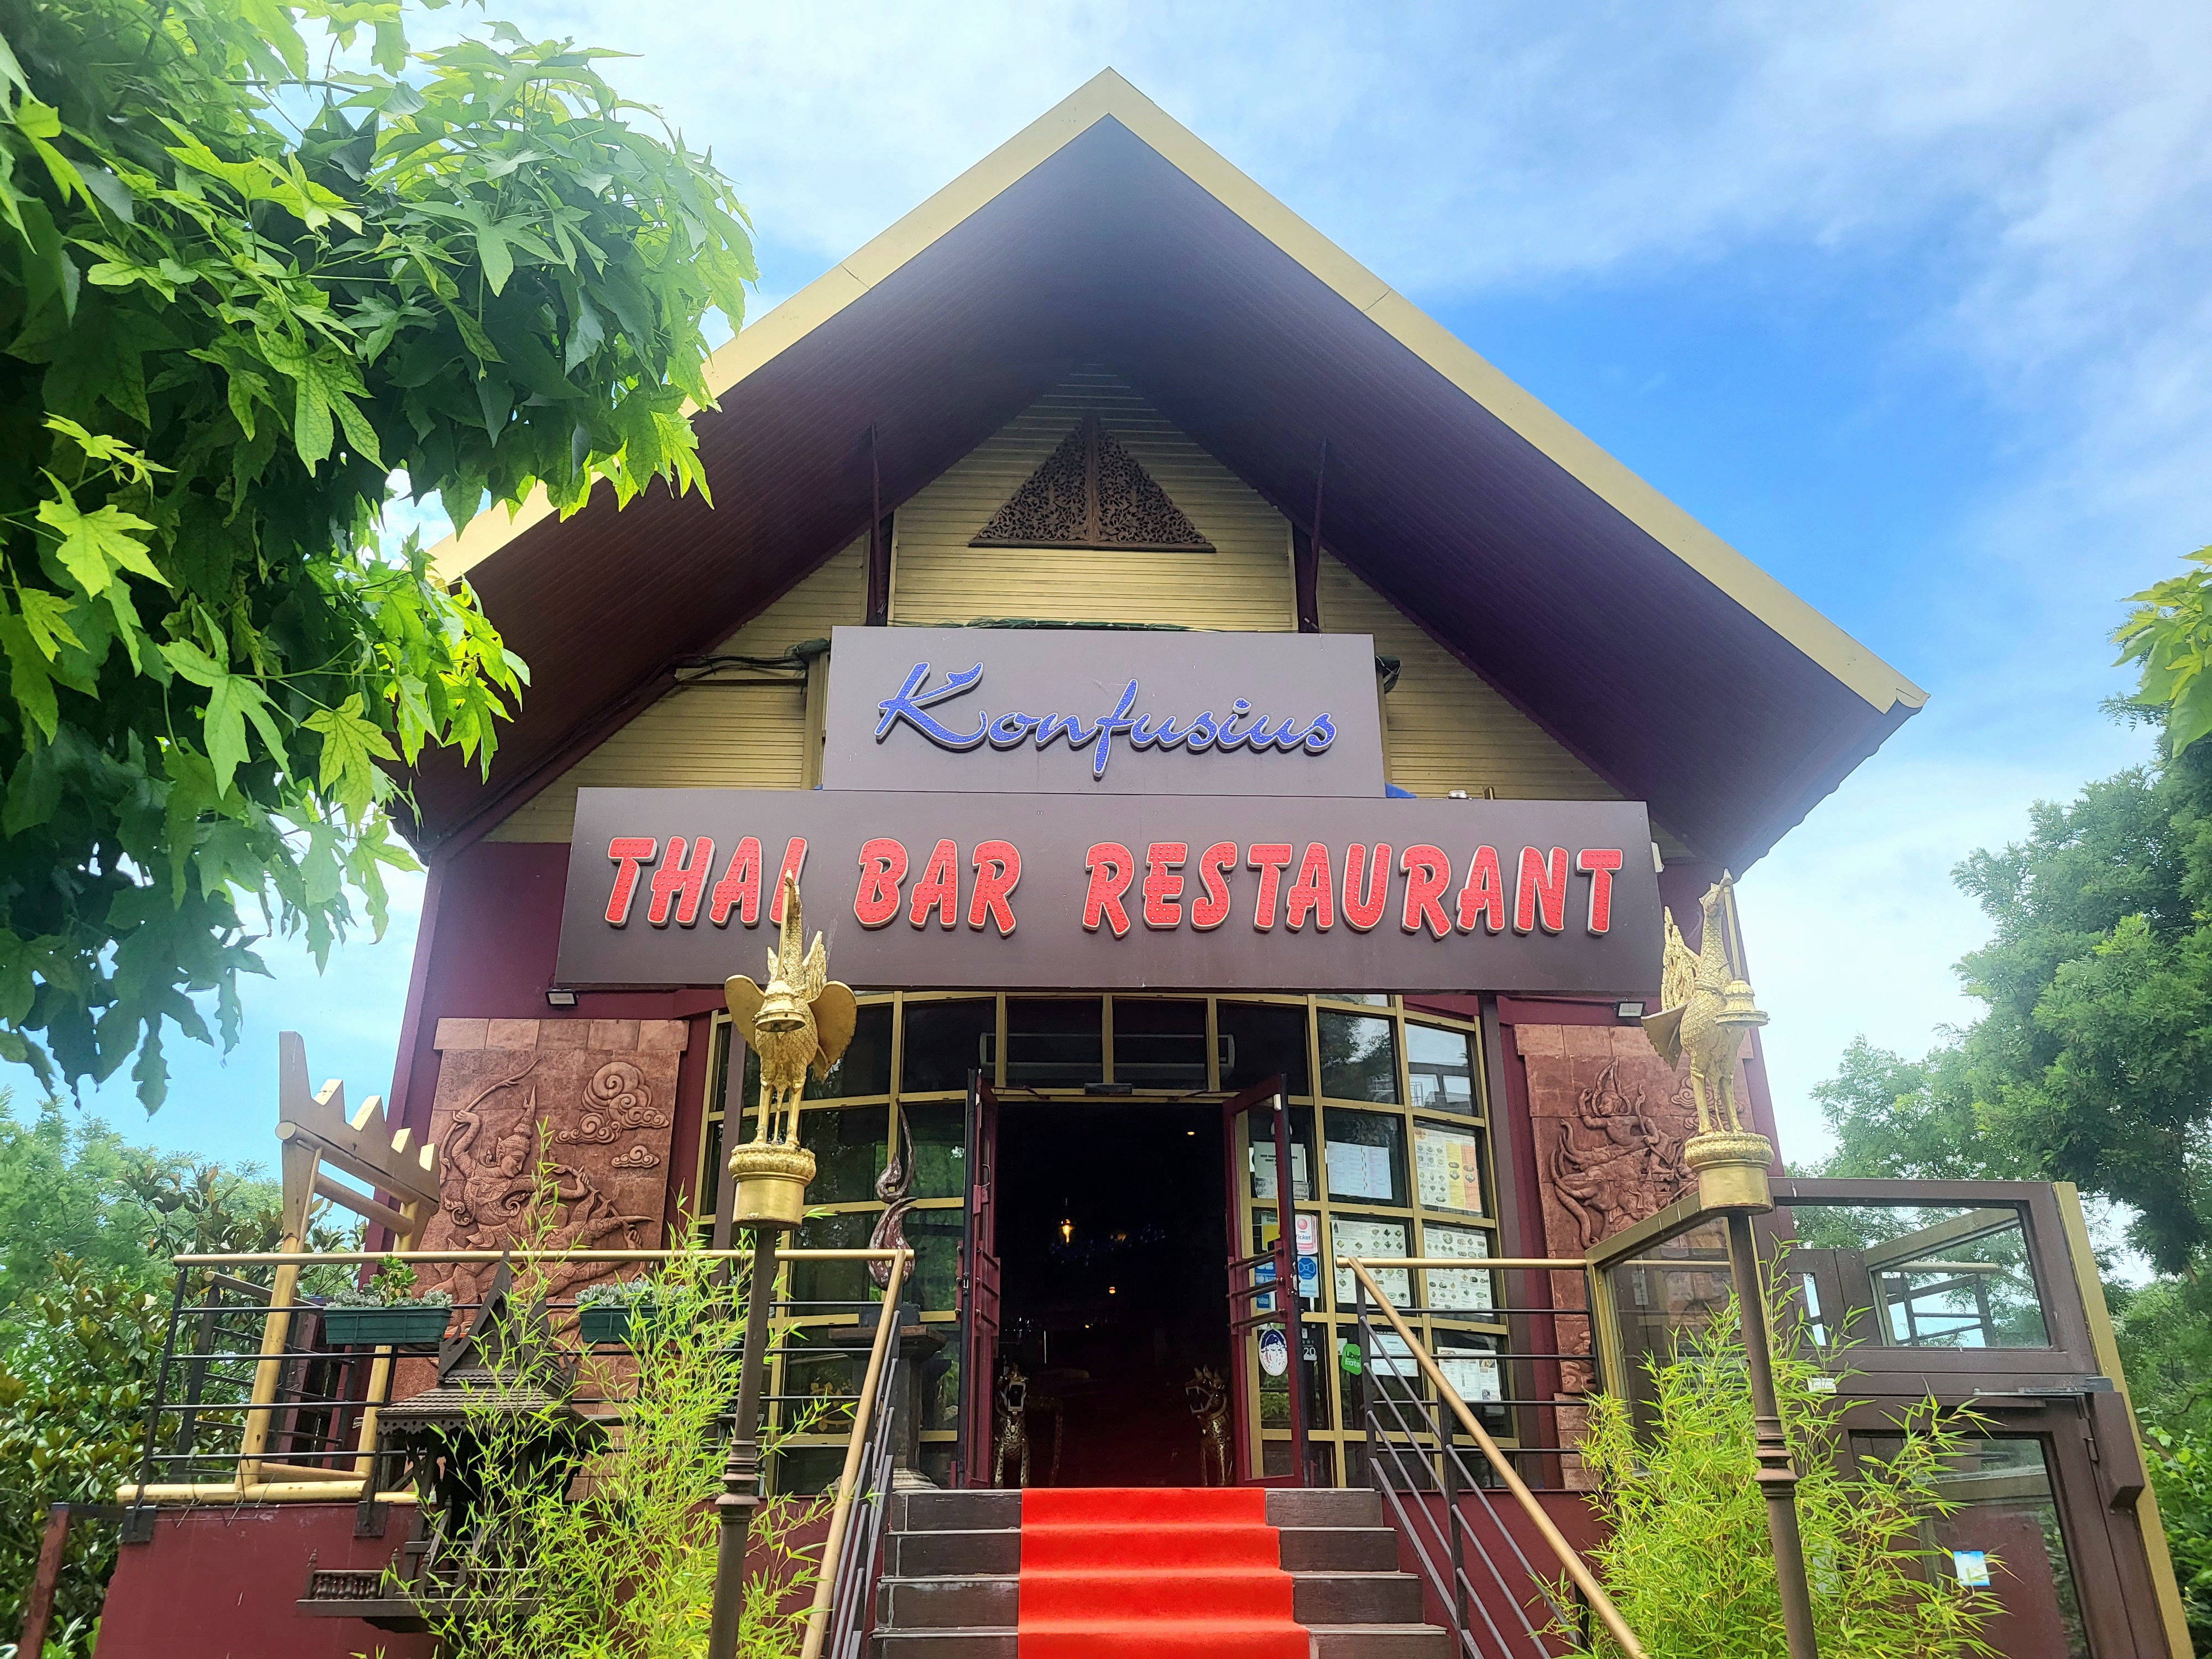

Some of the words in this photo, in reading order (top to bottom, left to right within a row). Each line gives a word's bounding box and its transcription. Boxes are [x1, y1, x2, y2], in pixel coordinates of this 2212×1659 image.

[875, 661, 1337, 778] Konfusius
[605, 836, 807, 926] THAI
[853, 838, 1021, 936] BAR
[1082, 841, 1623, 938] RESTAURANT
[1345, 1350, 1360, 1360] Uber
[1345, 1358, 1360, 1368] Eats
